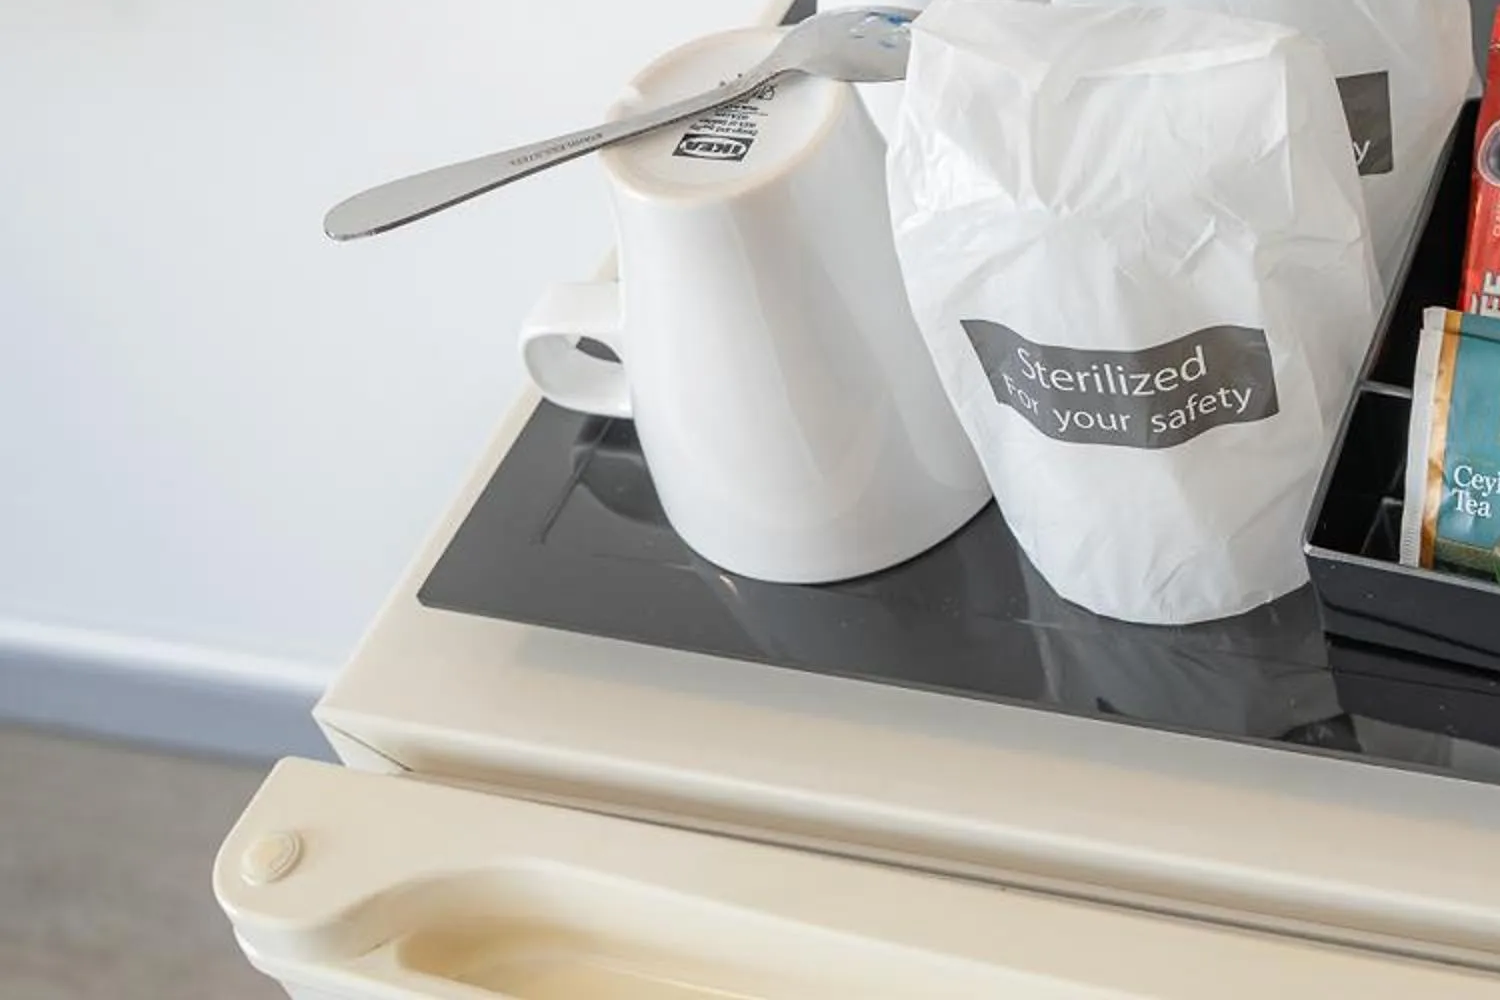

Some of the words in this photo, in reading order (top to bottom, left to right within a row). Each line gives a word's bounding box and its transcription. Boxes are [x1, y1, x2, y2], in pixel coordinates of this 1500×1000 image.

[683, 140, 743, 156] IKEA
[1016, 345, 1208, 396] Sterilized
[1001, 371, 1040, 416] For
[1053, 408, 1132, 433] your
[1150, 386, 1252, 433] safety
[1453, 488, 1492, 518] Tea
